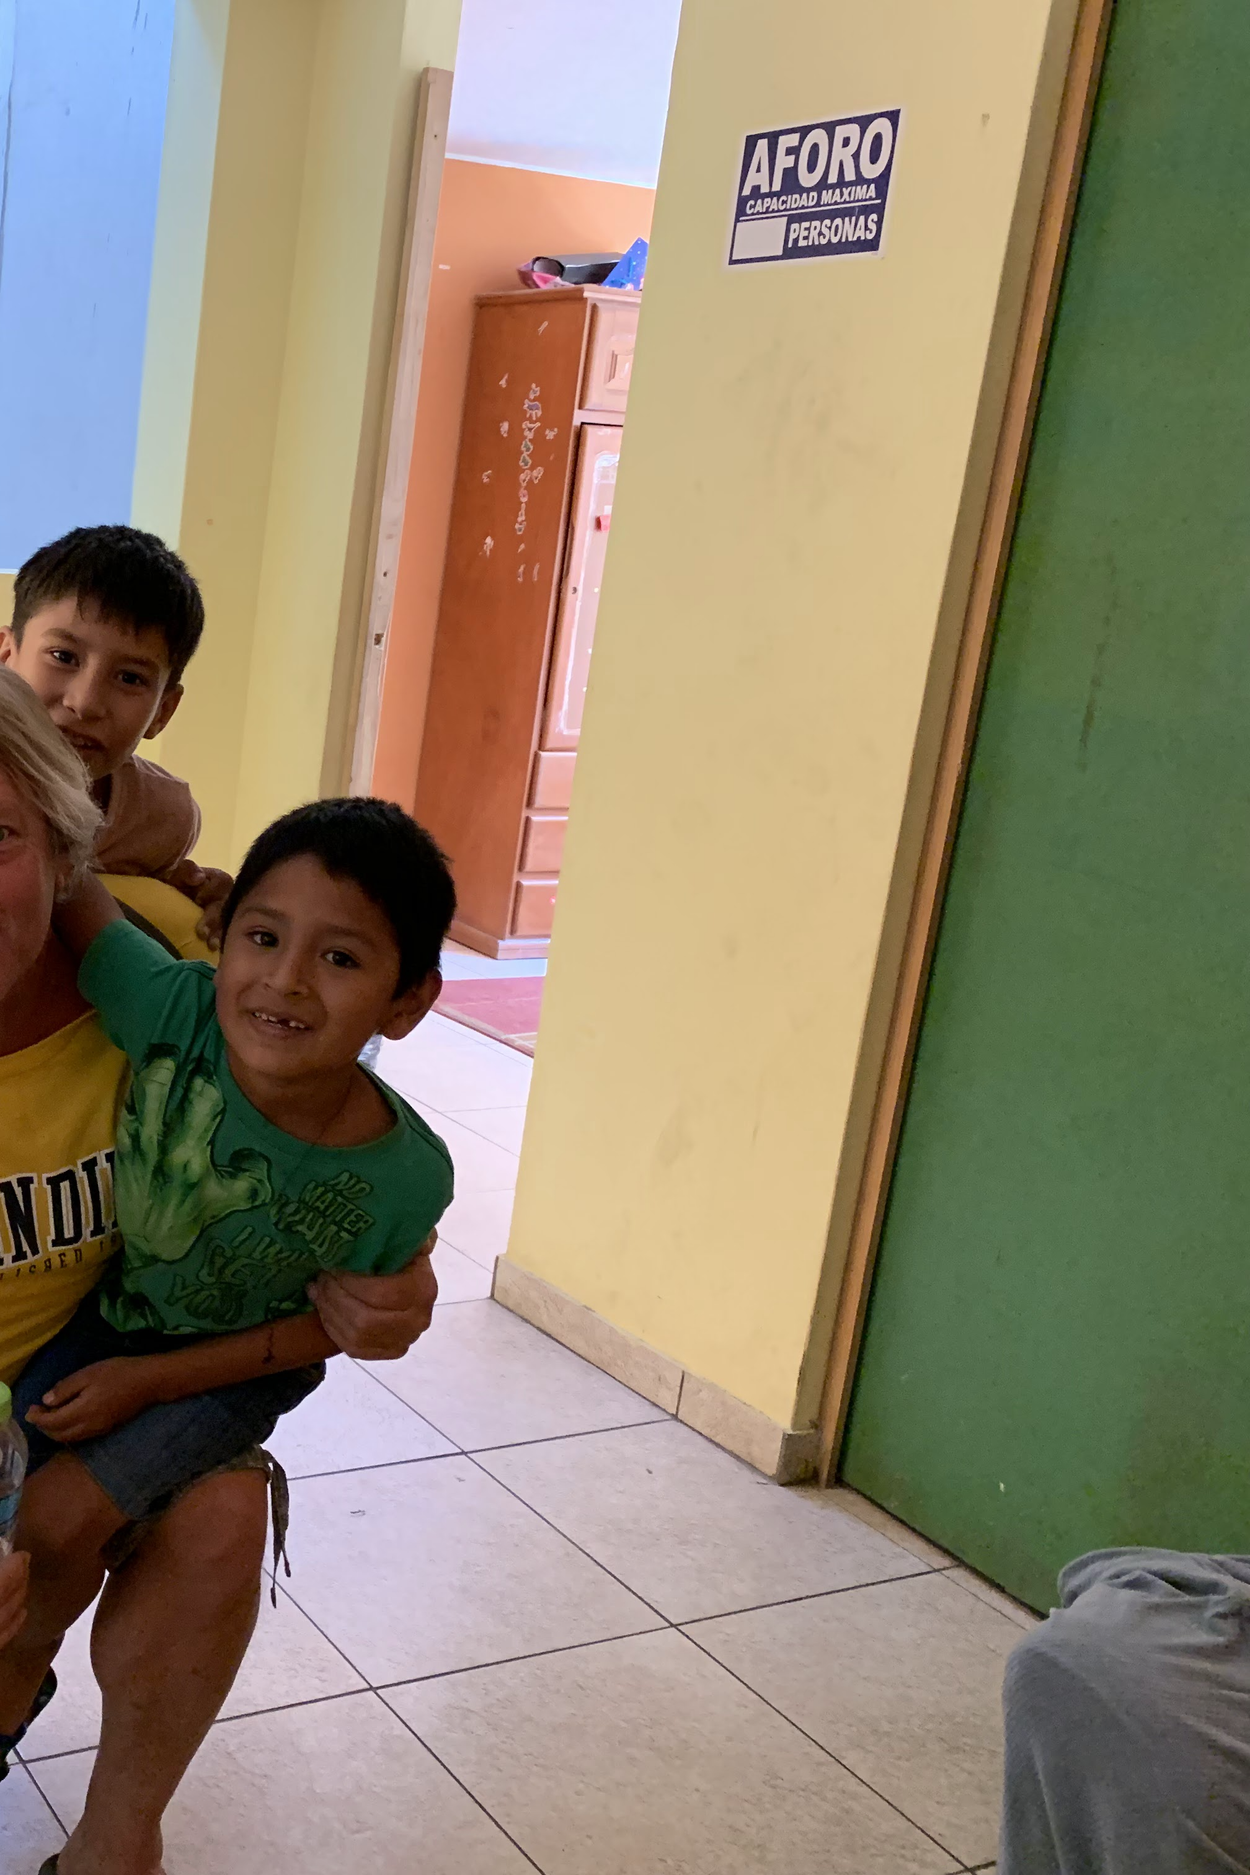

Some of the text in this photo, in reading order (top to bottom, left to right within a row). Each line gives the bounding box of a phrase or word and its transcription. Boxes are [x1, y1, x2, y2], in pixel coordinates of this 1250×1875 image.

[741, 117, 893, 196] AFORO
[746, 184, 876, 214] CAPACIDAD MAXIMA
[788, 213, 878, 248] PERSONAS
[326, 1170, 373, 1199] NO
[300, 1180, 375, 1237] MATTER
